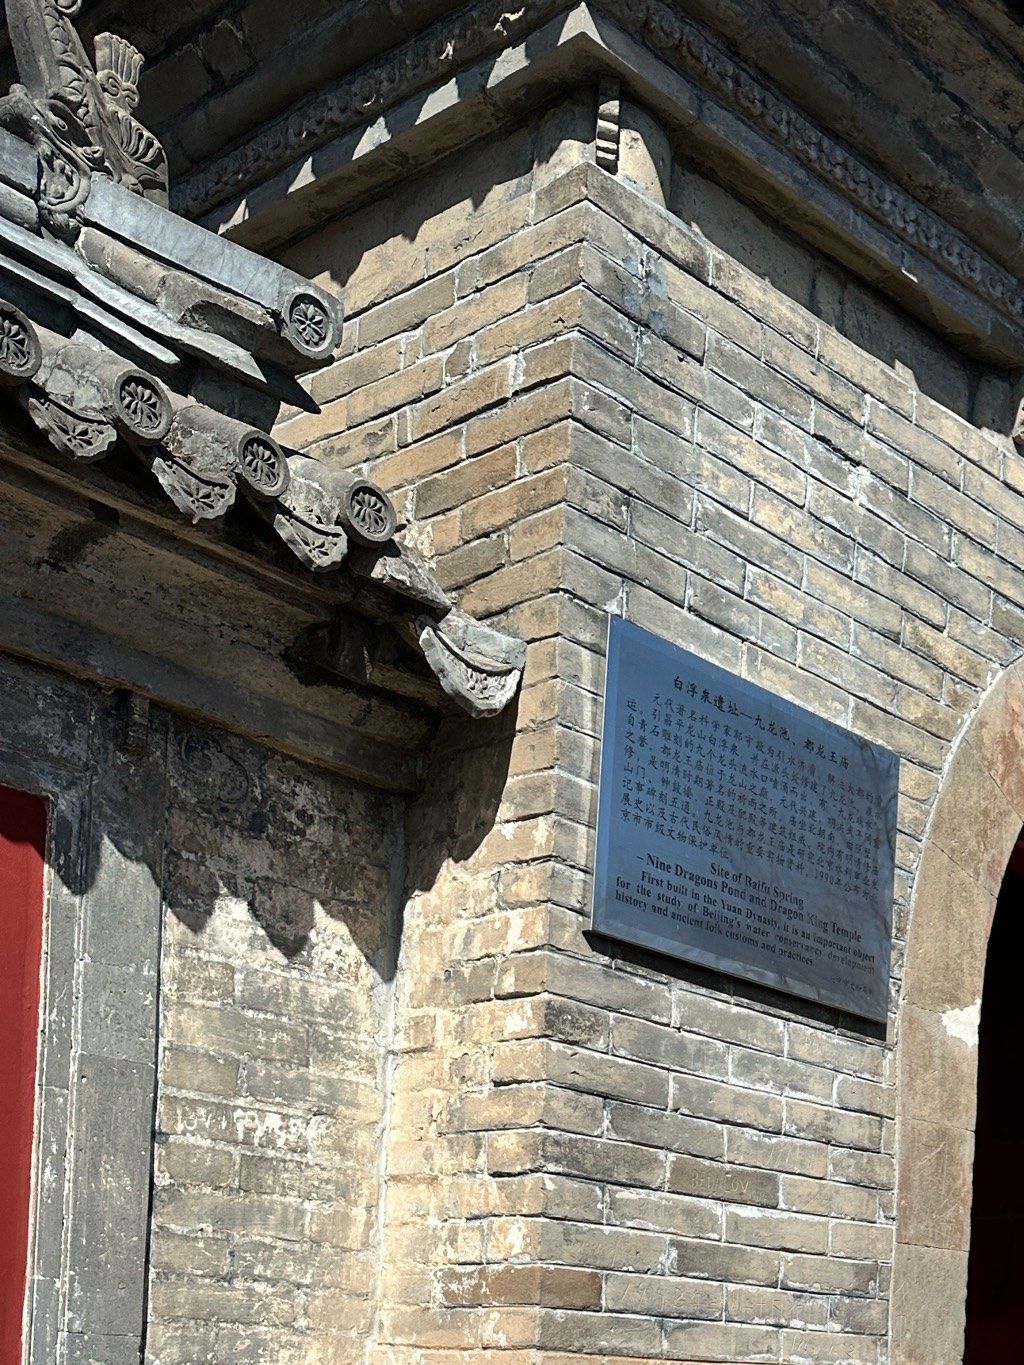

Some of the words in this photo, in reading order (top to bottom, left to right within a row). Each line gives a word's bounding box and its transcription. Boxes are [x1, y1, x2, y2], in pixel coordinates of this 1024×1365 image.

[615, 875, 630, 891] for
[635, 882, 652, 899] the
[656, 889, 681, 911] study
[687, 900, 696, 914] of
[746, 922, 770, 939] water
[640, 870, 663, 889] First
[666, 879, 688, 897] built
[691, 887, 700, 901] in
[703, 892, 717, 907] the
[720, 898, 742, 916] Yuan
[783, 920, 789, 932] it
[792, 923, 798, 936] is
[800, 929, 810, 940] an
[813, 932, 851, 957] important
[852, 946, 875, 966] object
[645, 852, 672, 874] Nine
[674, 863, 718, 893] Dragons
[721, 879, 745, 900] Pond
[748, 890, 766, 908] and
[769, 898, 804, 924] Dragon
[807, 912, 828, 933] King
[831, 921, 862, 945] Temple
[710, 861, 730, 880] Site
[731, 869, 742, 885] of
[772, 884, 804, 910] Spring
[614, 888, 647, 913] history
[651, 901, 668, 917] and
[670, 908, 703, 929] ancient
[705, 919, 723, 936] folk
[725, 926, 758, 948] customs
[760, 938, 775, 953] and
